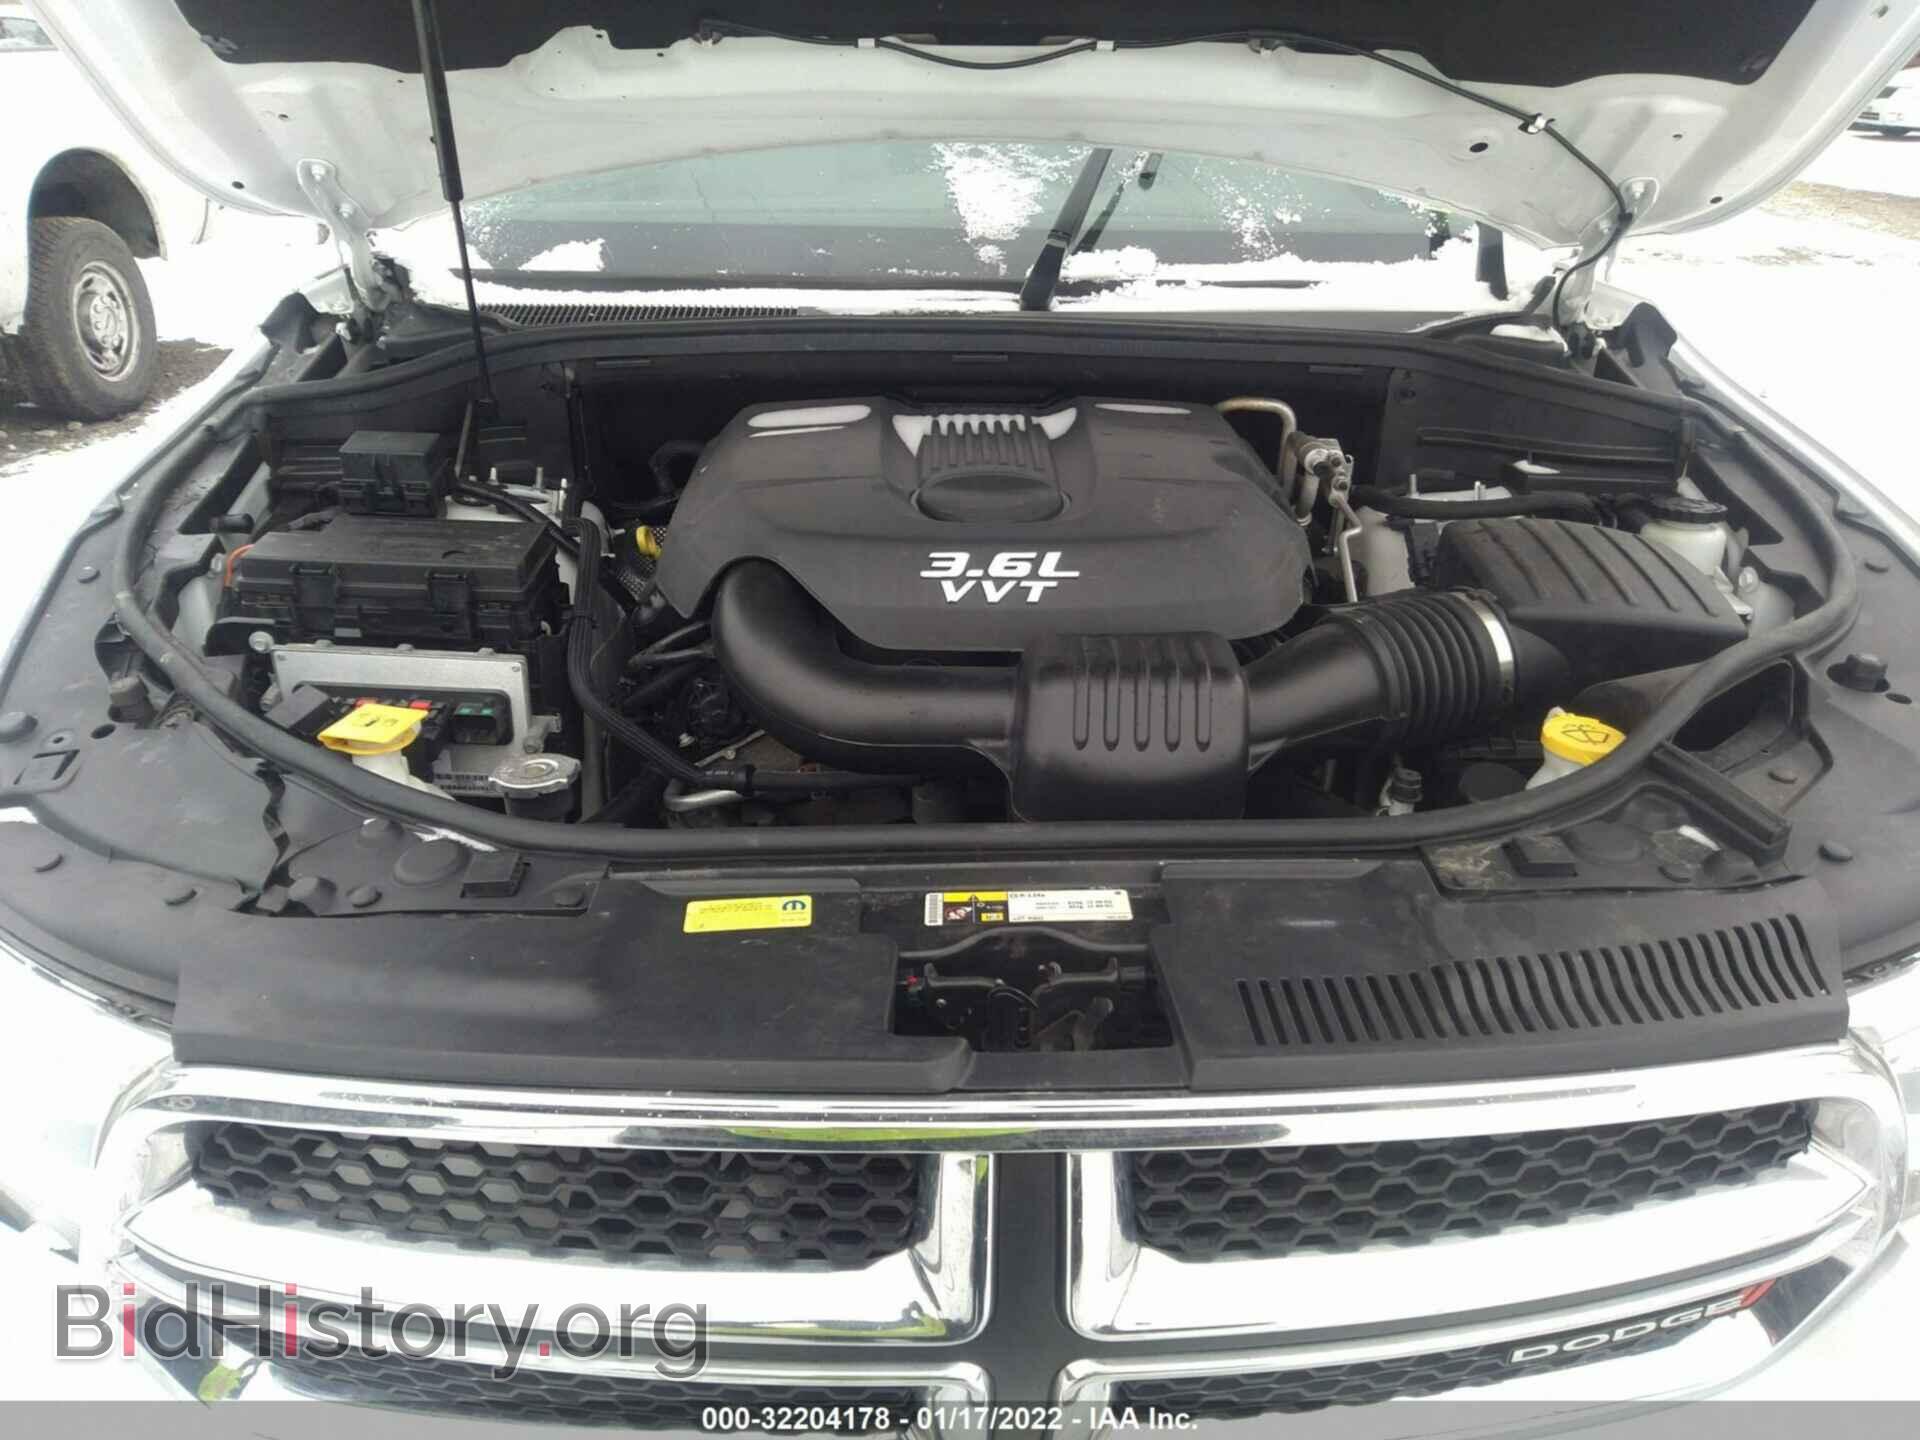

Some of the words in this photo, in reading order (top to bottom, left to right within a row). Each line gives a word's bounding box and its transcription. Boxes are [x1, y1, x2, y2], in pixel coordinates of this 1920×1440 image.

[920, 551, 1080, 577] 3.6L
[940, 579, 1058, 603] VVT
[1511, 1294, 1746, 1363] DODGE
